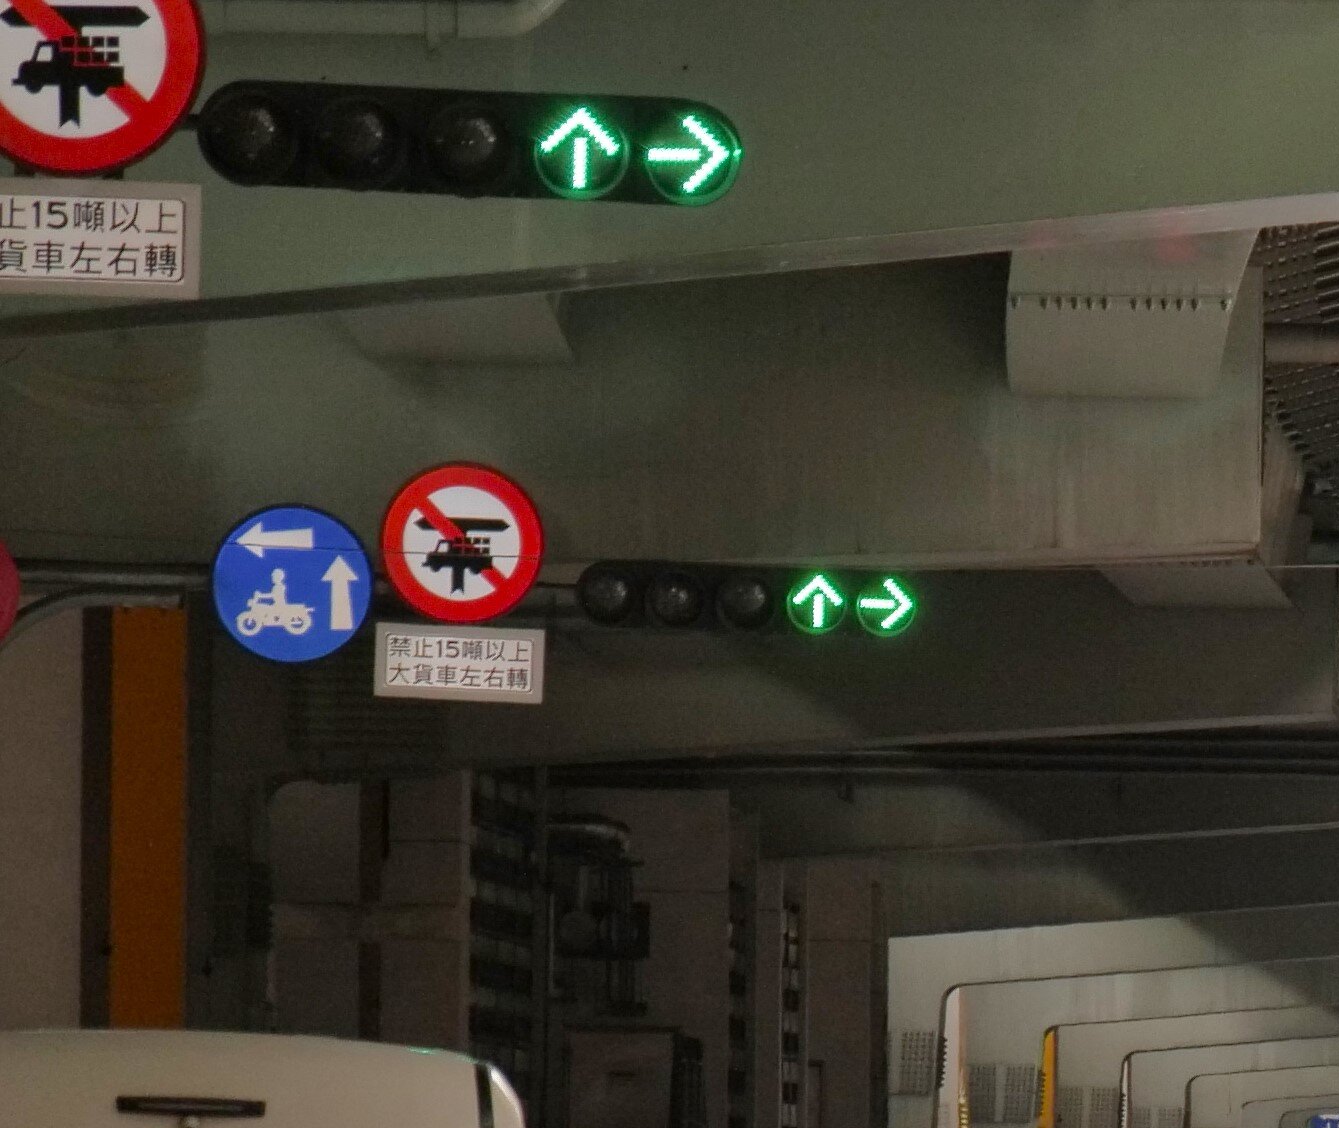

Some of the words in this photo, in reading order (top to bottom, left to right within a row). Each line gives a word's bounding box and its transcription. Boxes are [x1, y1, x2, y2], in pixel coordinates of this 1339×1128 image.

[0, 197, 178, 234] 止15噸以上
[0, 239, 178, 278] 貨車左右轉
[389, 636, 530, 662] 禁止15噸以上
[389, 662, 529, 689] 大貨車左右轉
